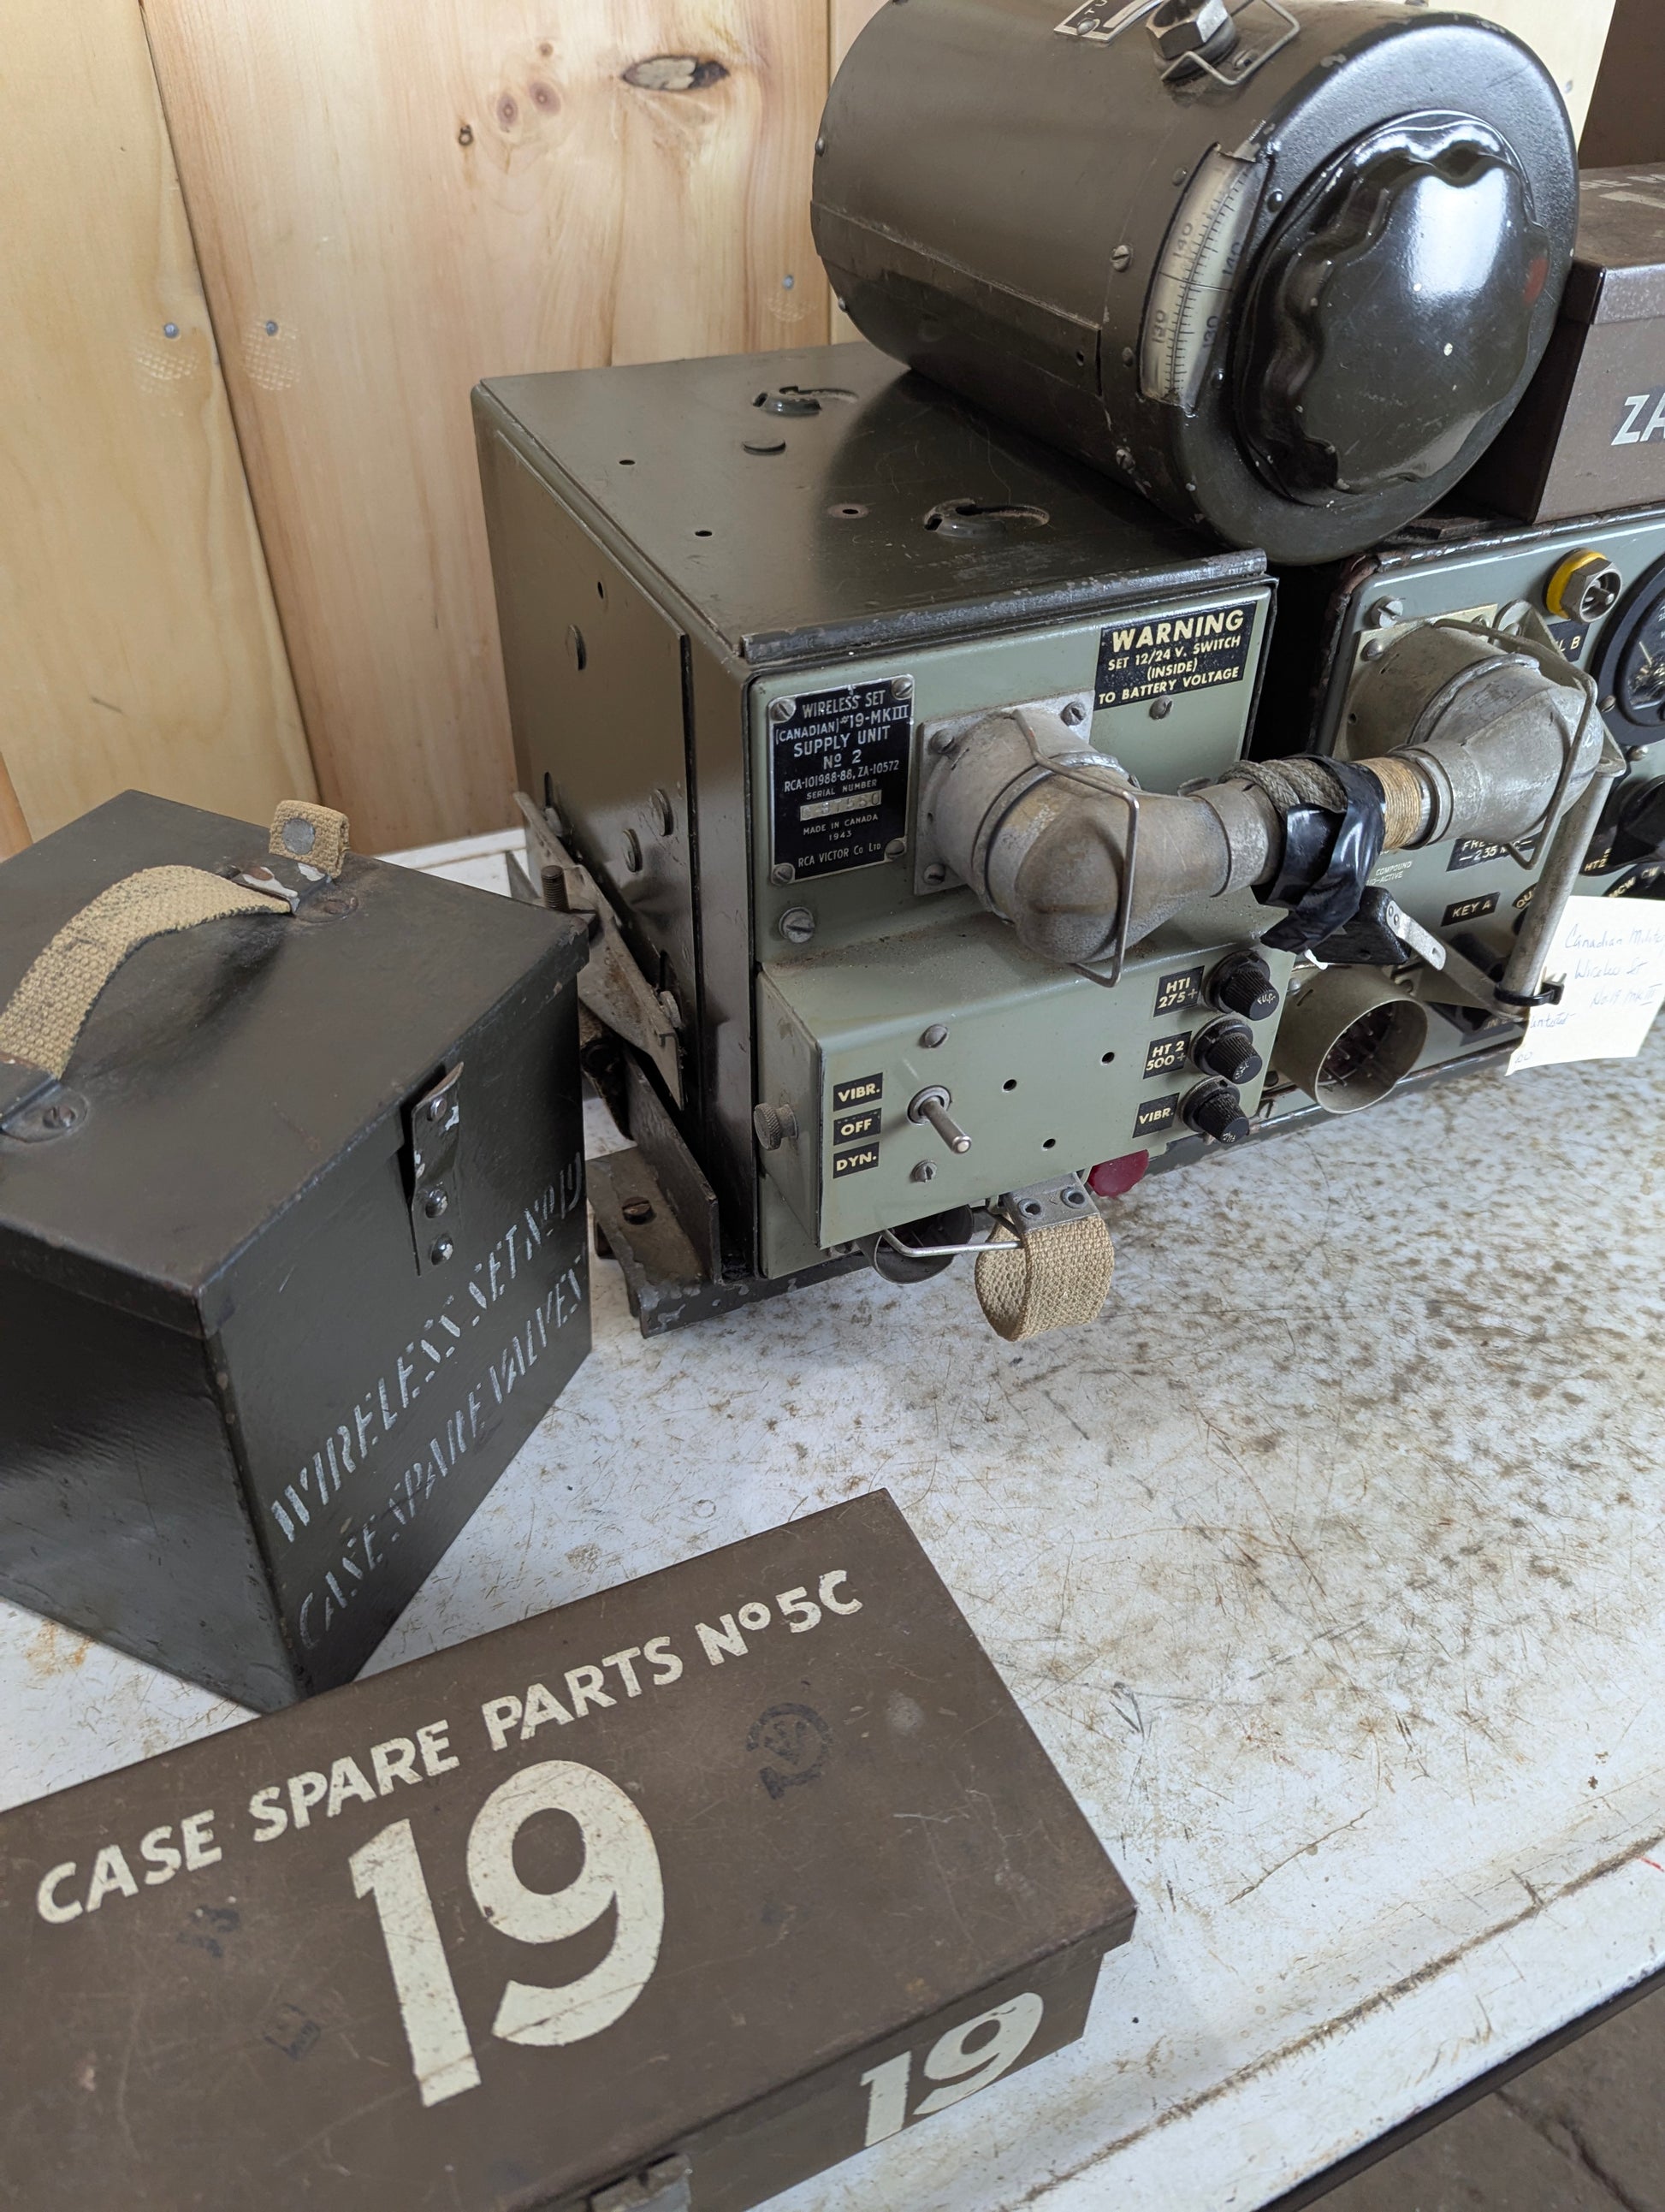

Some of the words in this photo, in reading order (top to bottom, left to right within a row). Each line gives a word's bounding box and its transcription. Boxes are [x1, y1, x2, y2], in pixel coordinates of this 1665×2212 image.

[1112, 609, 1244, 653] WARNING
[1108, 656, 1129, 671] SET
[1135, 648, 1171, 666] 12/24
[1175, 646, 1188, 658] V.
[1193, 635, 1241, 655] SWITCH
[1570, 635, 1581, 650] B
[1147, 657, 1198, 681] (INSIDE)
[1099, 691, 1116, 705] TO
[1122, 679, 1177, 700] BATTERY
[1182, 667, 1240, 688] VOLTAGE
[802, 694, 861, 719] WIRELESS
[865, 690, 886, 708] SET
[794, 732, 850, 757] SUPPLY
[857, 725, 891, 744] UNIT
[851, 749, 862, 765] 2
[806, 787, 836, 800] SERIAL
[842, 779, 878, 792] NUMBER
[803, 823, 827, 835] MADE
[831, 821, 839, 829] IN
[844, 814, 879, 827] CANADA
[829, 831, 852, 841] 1943
[798, 855, 815, 868] RCA
[819, 847, 850, 863] VICTOR
[1376, 860, 1413, 876] COMPOUND
[1452, 902, 1477, 918] KEY
[1483, 900, 1491, 910] A
[1516, 890, 1535, 909] QU
[1152, 1043, 1171, 1059] HT
[1175, 1041, 1185, 1053] 2
[838, 1082, 880, 1102] VIBR.
[1139, 1107, 1174, 1124] VIBR.
[840, 1118, 872, 1136] OFF
[836, 1152, 877, 1171] DYN.
[36, 1809, 222, 1924] CASE
[249, 1719, 459, 1842] SPARE
[481, 1636, 684, 1752] PARTS
[348, 1759, 665, 2108] 19
[860, 1992, 1044, 2148] 19
